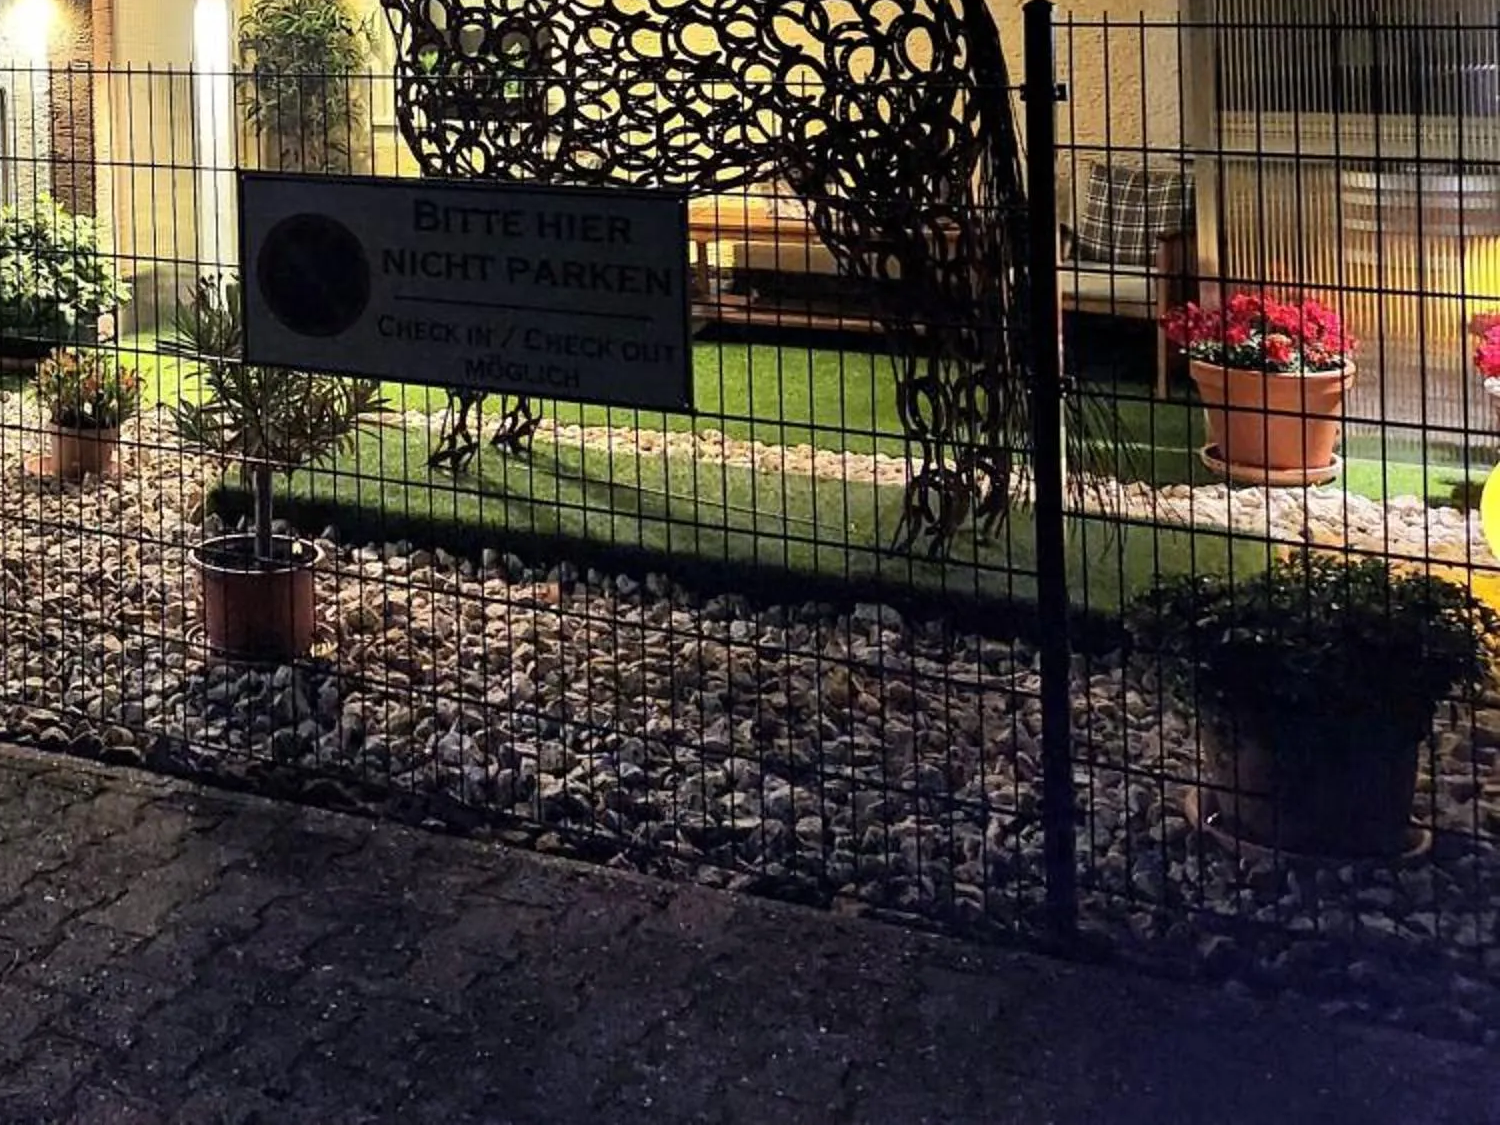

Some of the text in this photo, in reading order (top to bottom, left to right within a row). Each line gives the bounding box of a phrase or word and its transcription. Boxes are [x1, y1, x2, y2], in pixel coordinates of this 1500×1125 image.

[412, 199, 634, 245] BITTE HIER
[382, 248, 674, 297] NICHT PARKEN
[377, 313, 458, 346] CHECK
[466, 327, 492, 348] IN
[523, 327, 614, 359] CHECK
[621, 340, 679, 364] OUT
